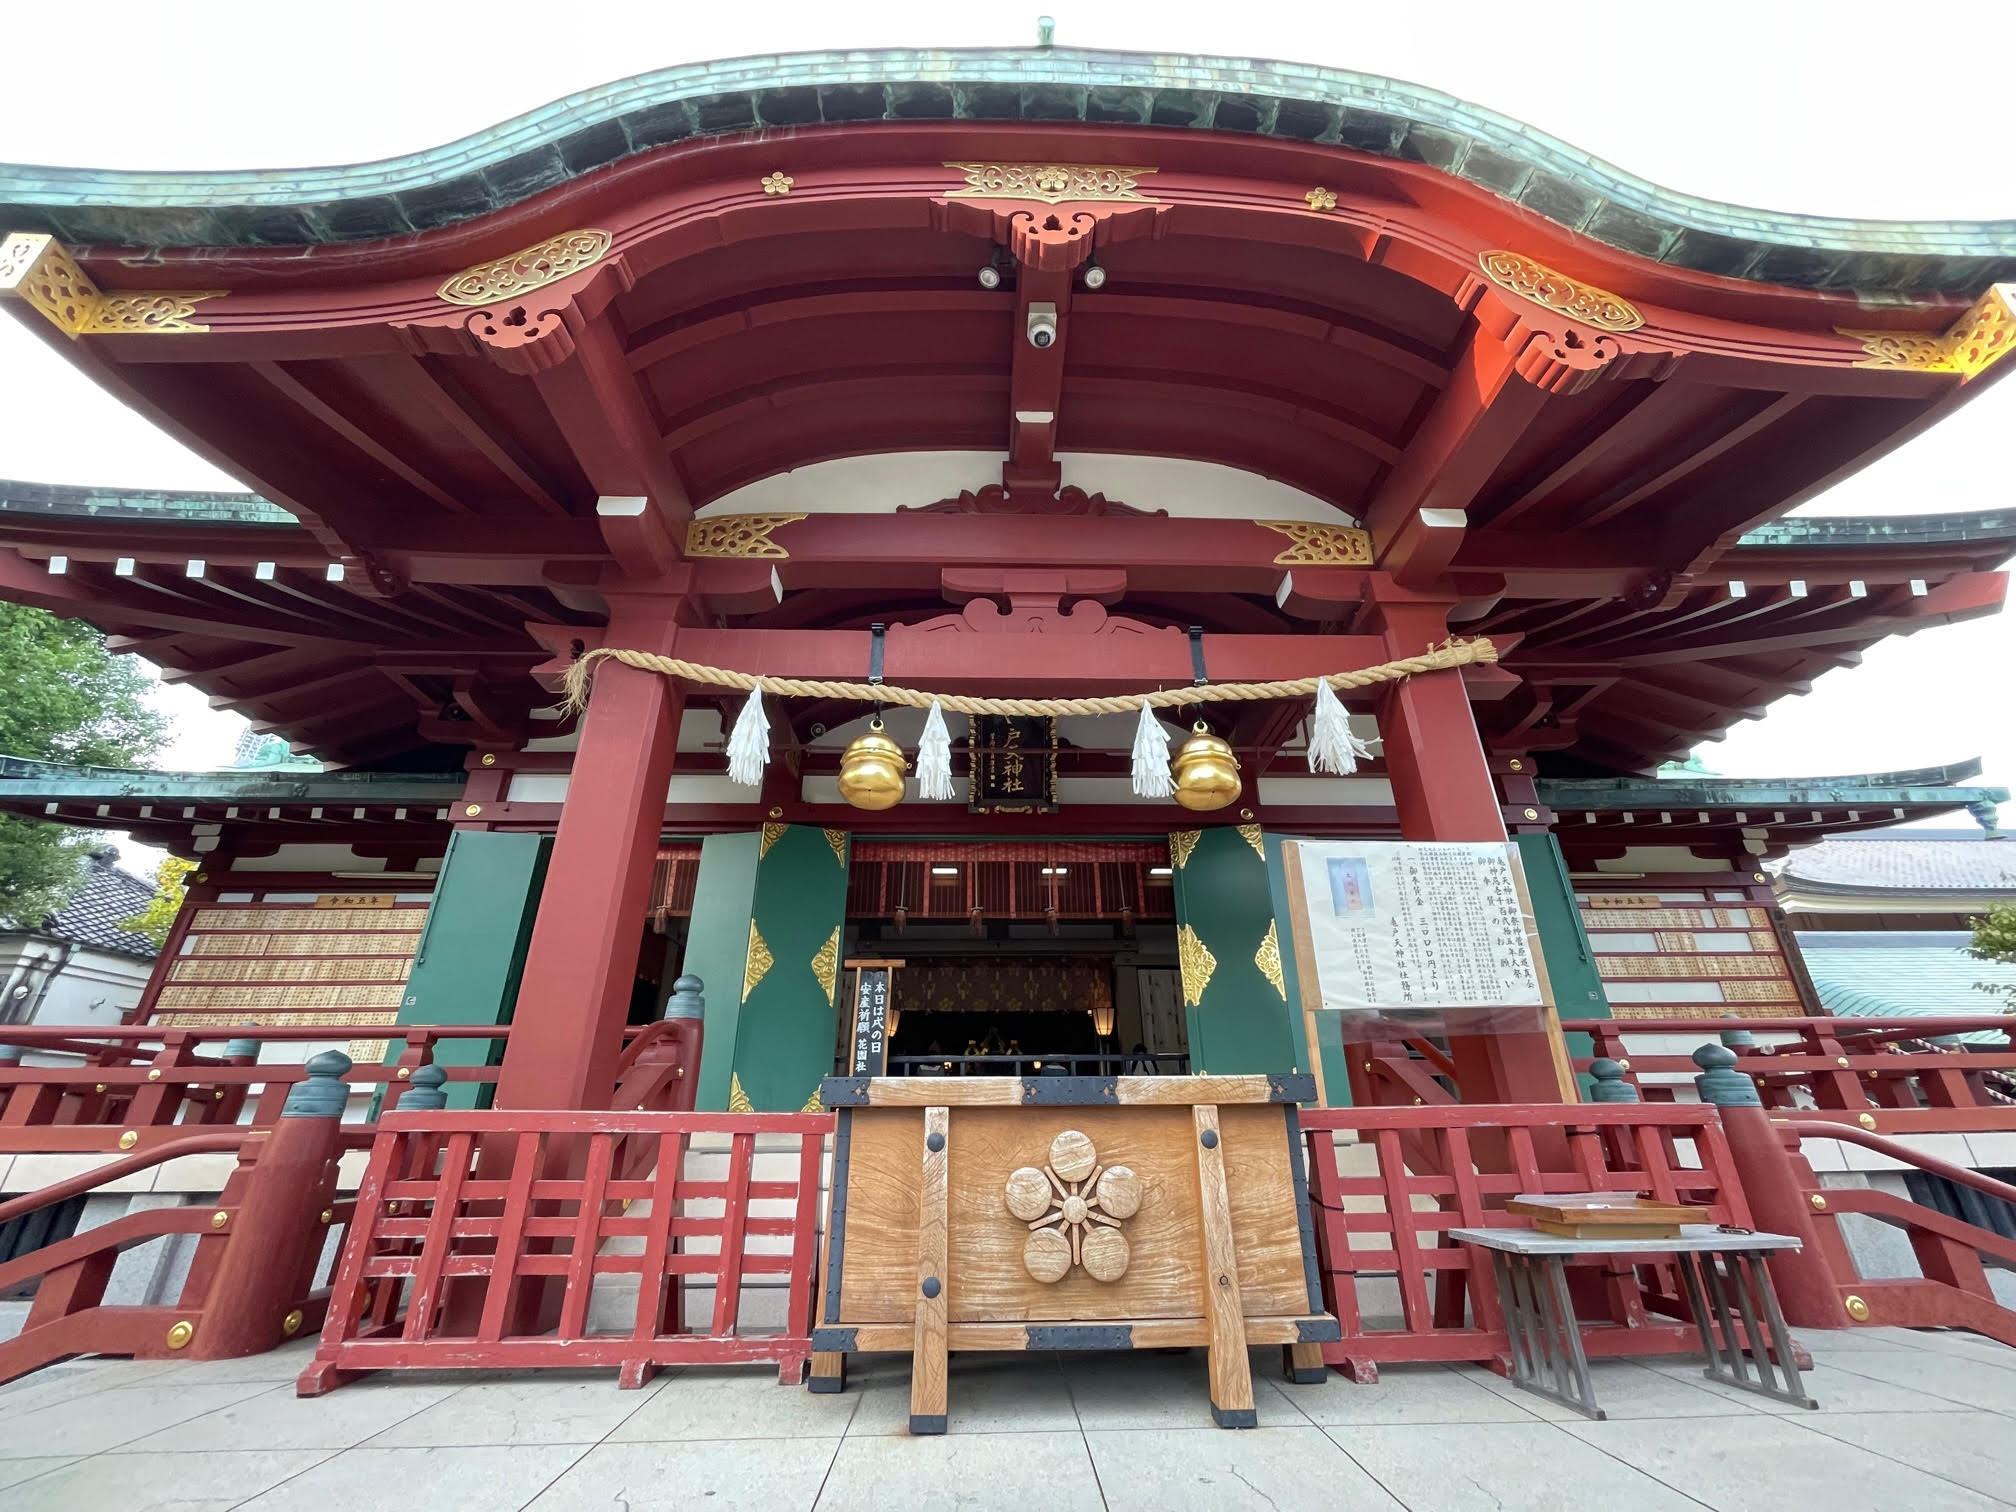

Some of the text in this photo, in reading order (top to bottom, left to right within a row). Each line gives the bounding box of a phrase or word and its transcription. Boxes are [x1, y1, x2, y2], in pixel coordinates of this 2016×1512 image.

[855, 981, 872, 1072] 安産祈願 花園社
[871, 981, 886, 1053] 本日は戌の日
